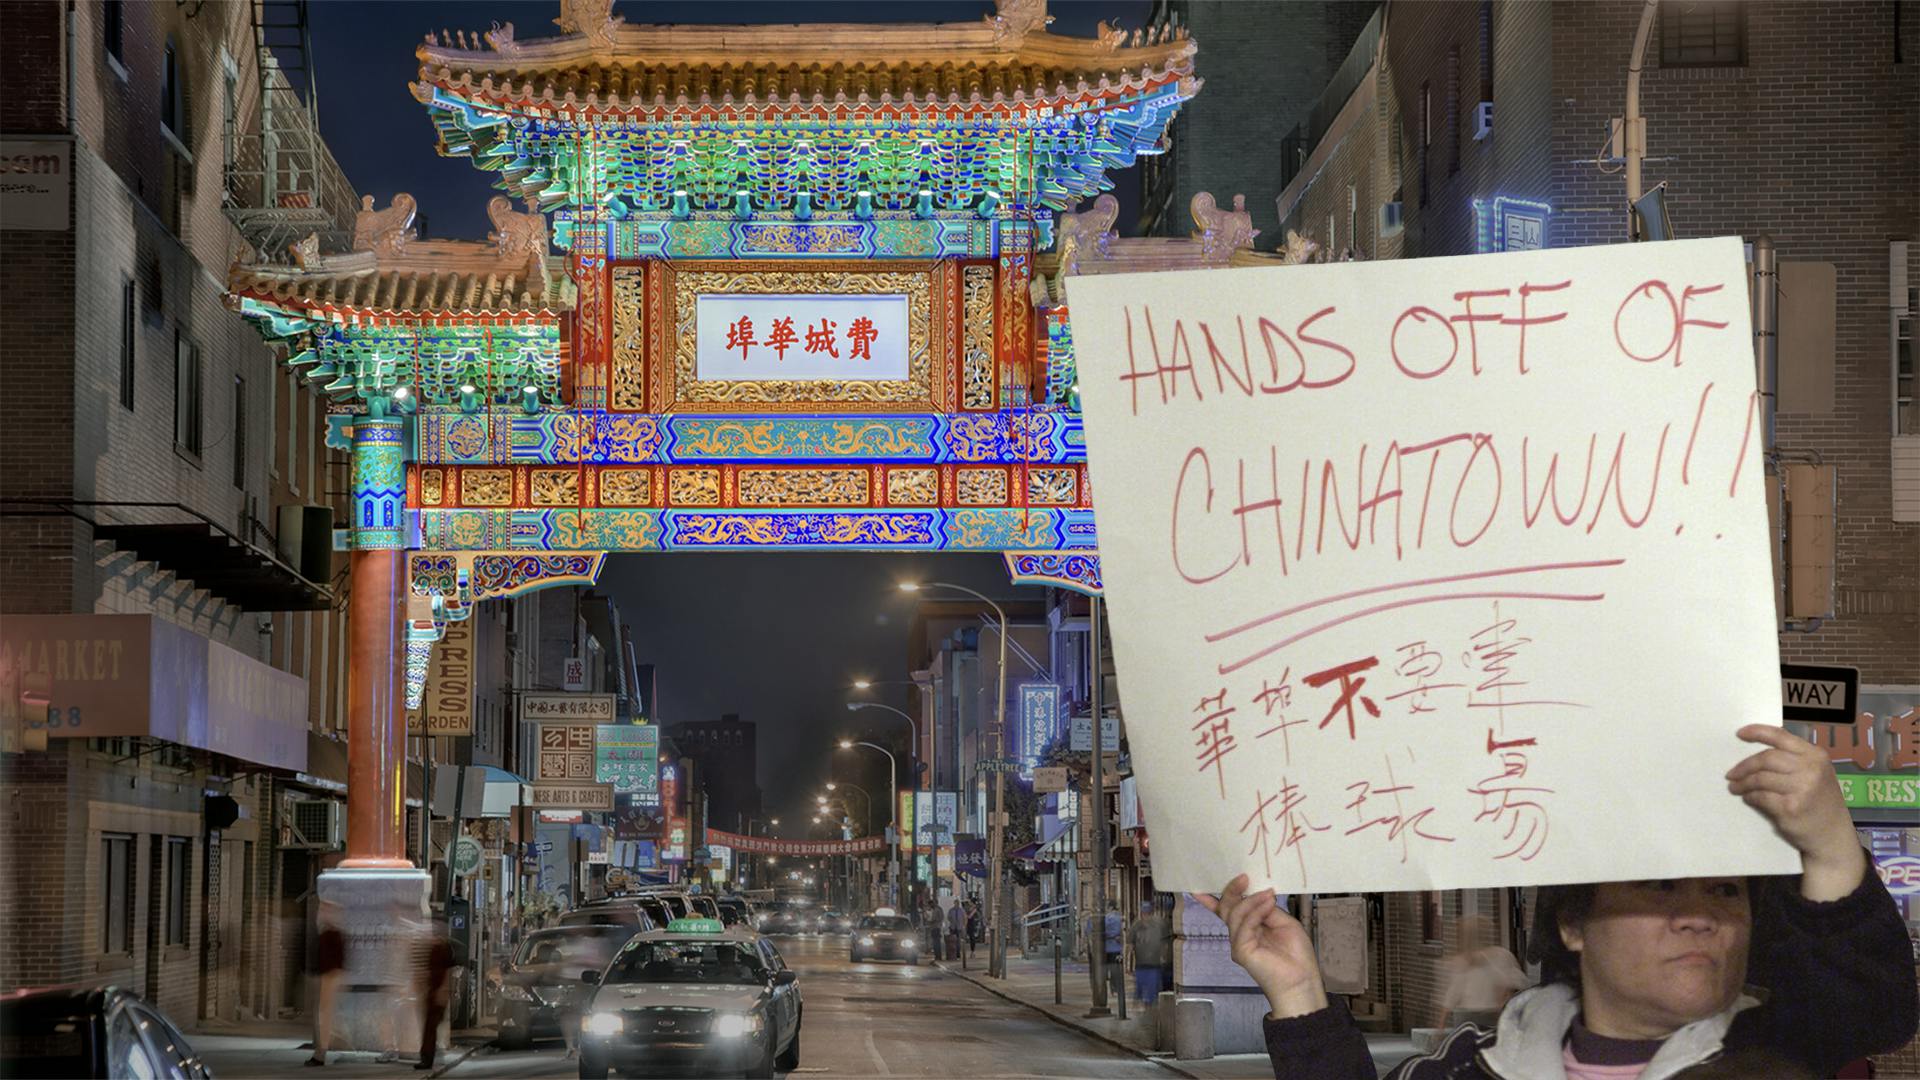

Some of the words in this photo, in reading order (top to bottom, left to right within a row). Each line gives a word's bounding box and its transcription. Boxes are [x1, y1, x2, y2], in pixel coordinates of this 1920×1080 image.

[1120, 305, 1355, 416] HANDS
[1391, 281, 1572, 379] OFF
[1614, 280, 1730, 367] OF
[1171, 382, 1758, 584] CHINATOWN!!
[1787, 682, 1838, 705] WAY
[1867, 779, 1920, 802] RES
